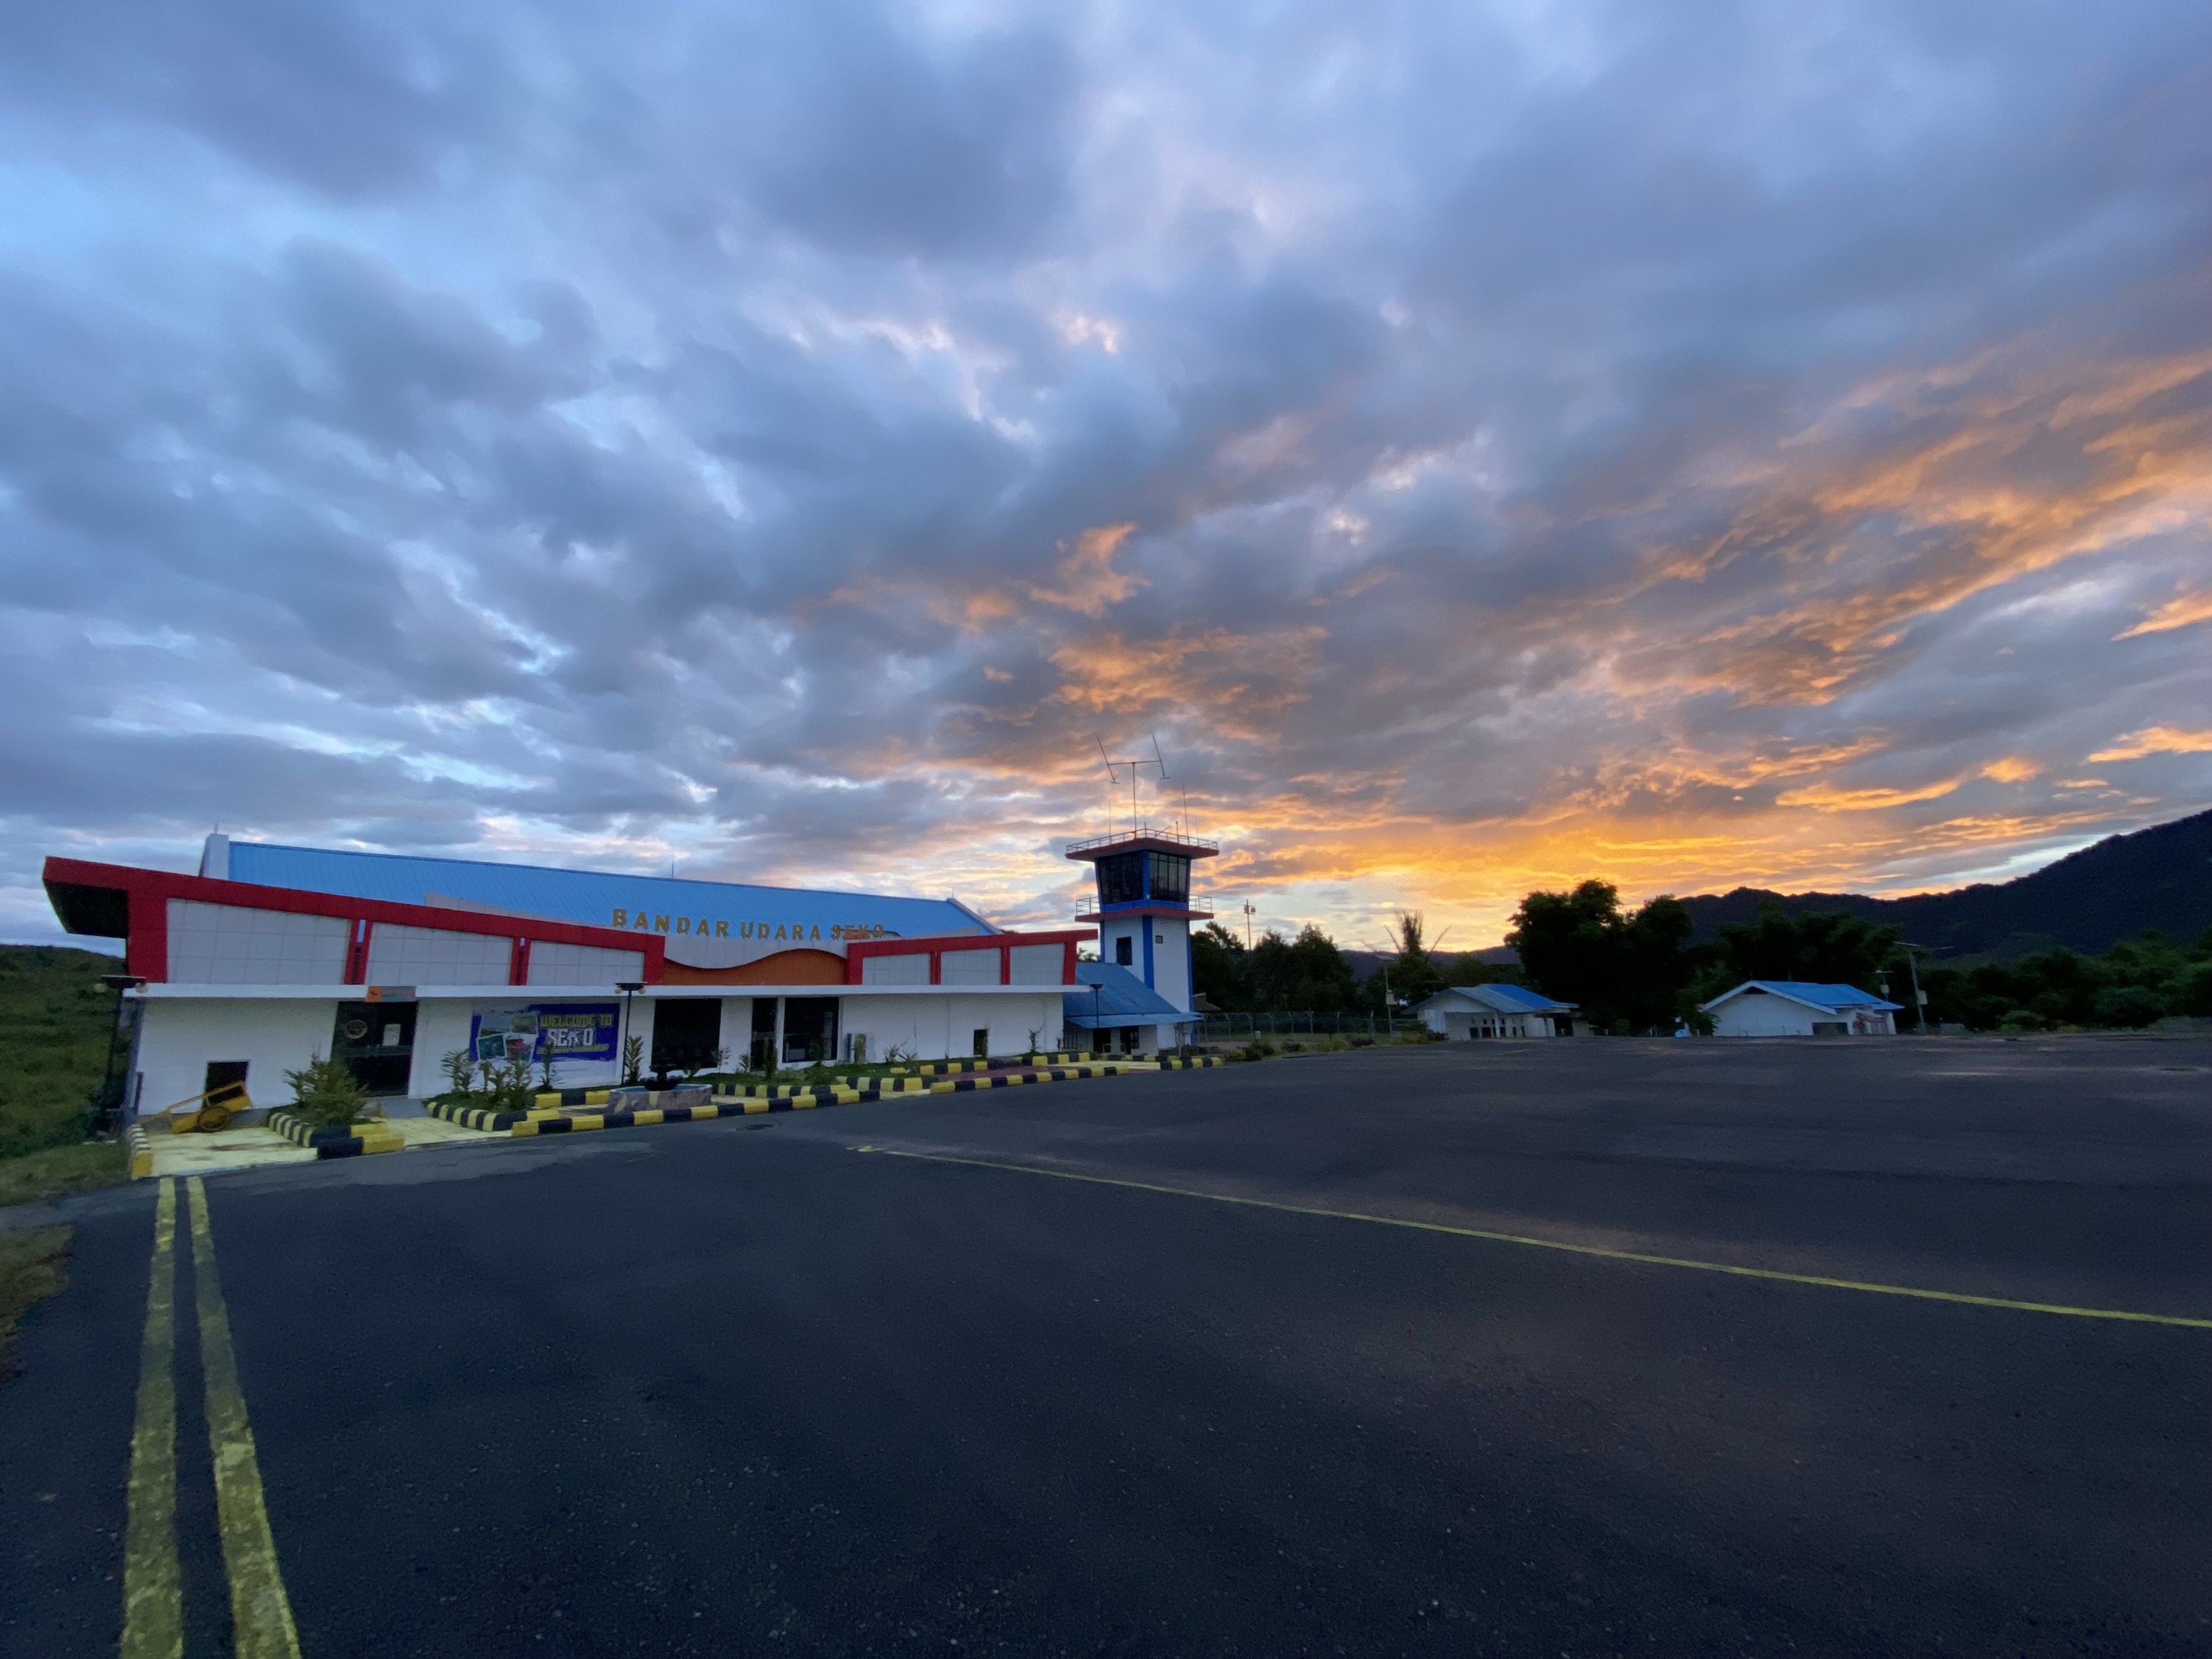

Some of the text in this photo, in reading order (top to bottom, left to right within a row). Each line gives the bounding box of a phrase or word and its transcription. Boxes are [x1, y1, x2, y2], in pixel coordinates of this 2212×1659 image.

[612, 908, 885, 941] BANDAR UDARA SEKO
[541, 1014, 596, 1028] WELCOME
